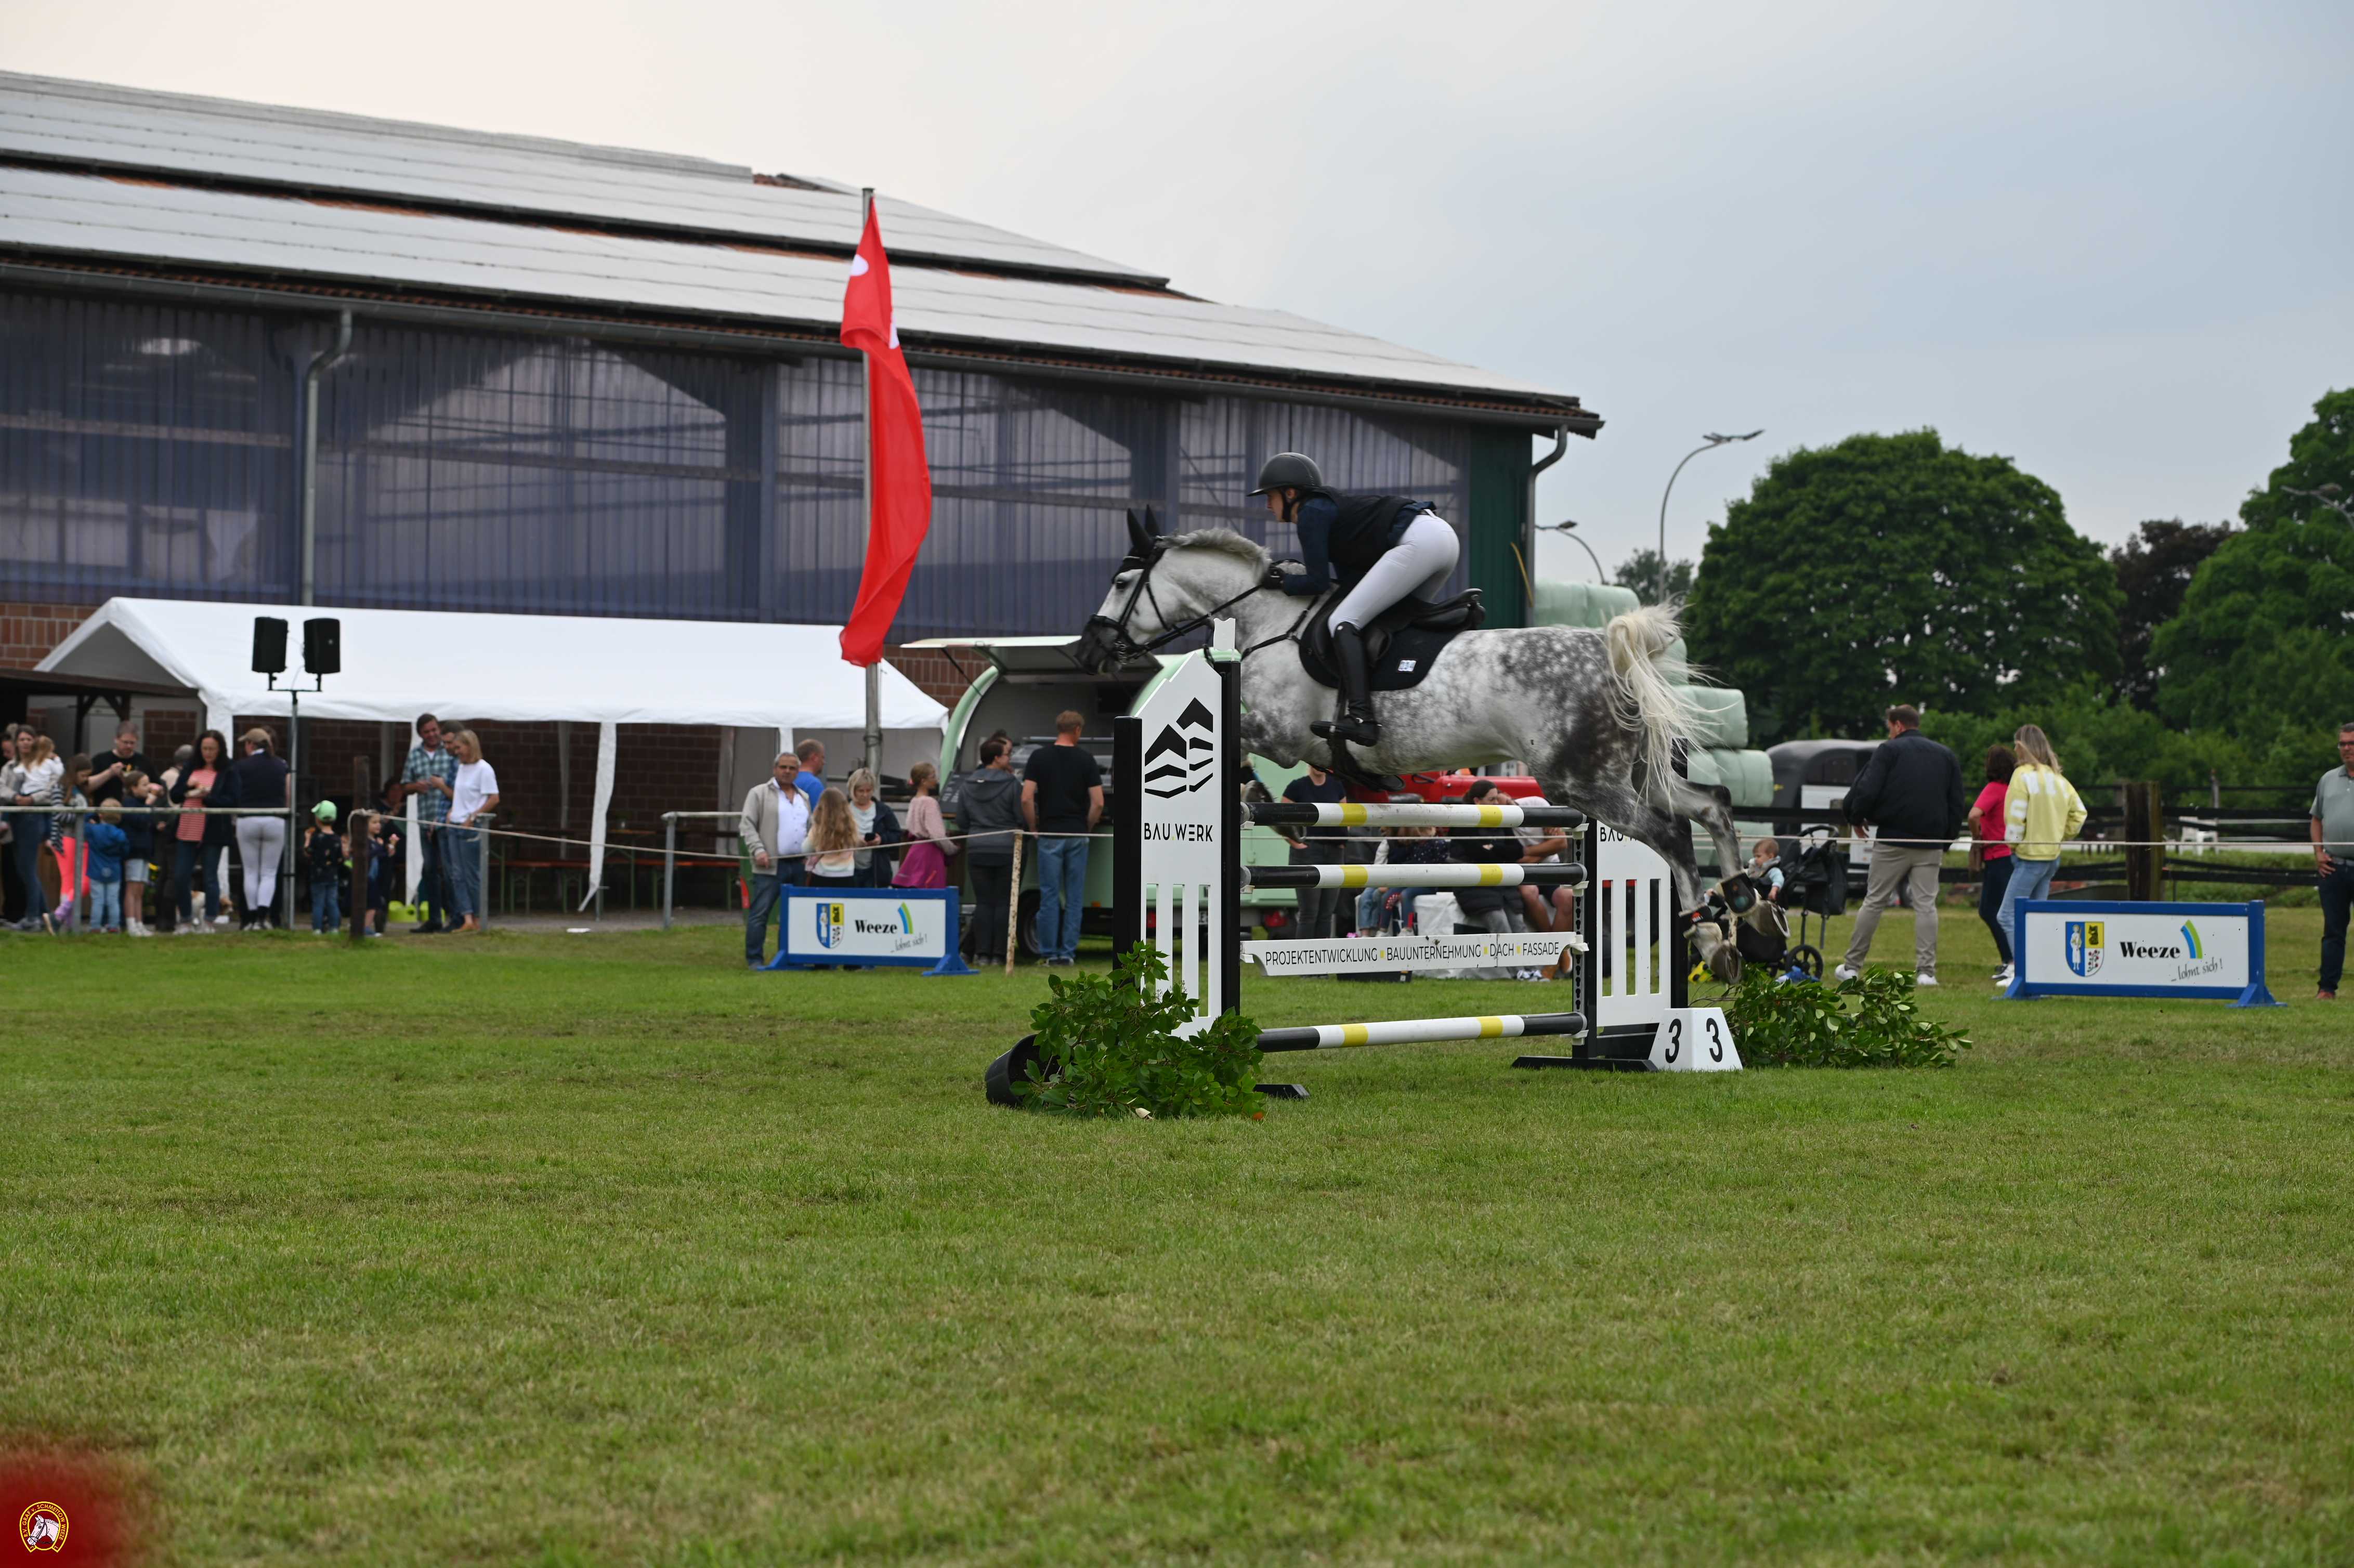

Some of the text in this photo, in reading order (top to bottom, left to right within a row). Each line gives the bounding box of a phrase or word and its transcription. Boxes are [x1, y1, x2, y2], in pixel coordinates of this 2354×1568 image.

[855, 920, 897, 934] Weeze
[1265, 942, 1559, 965] PROJEKTENTWICKLUNG BAUUNTERNEHMUNG DACH FASSADE
[2120, 942, 2180, 958] Weeze
[1665, 1018, 1681, 1063] 3
[1706, 1017, 1722, 1062] 3
